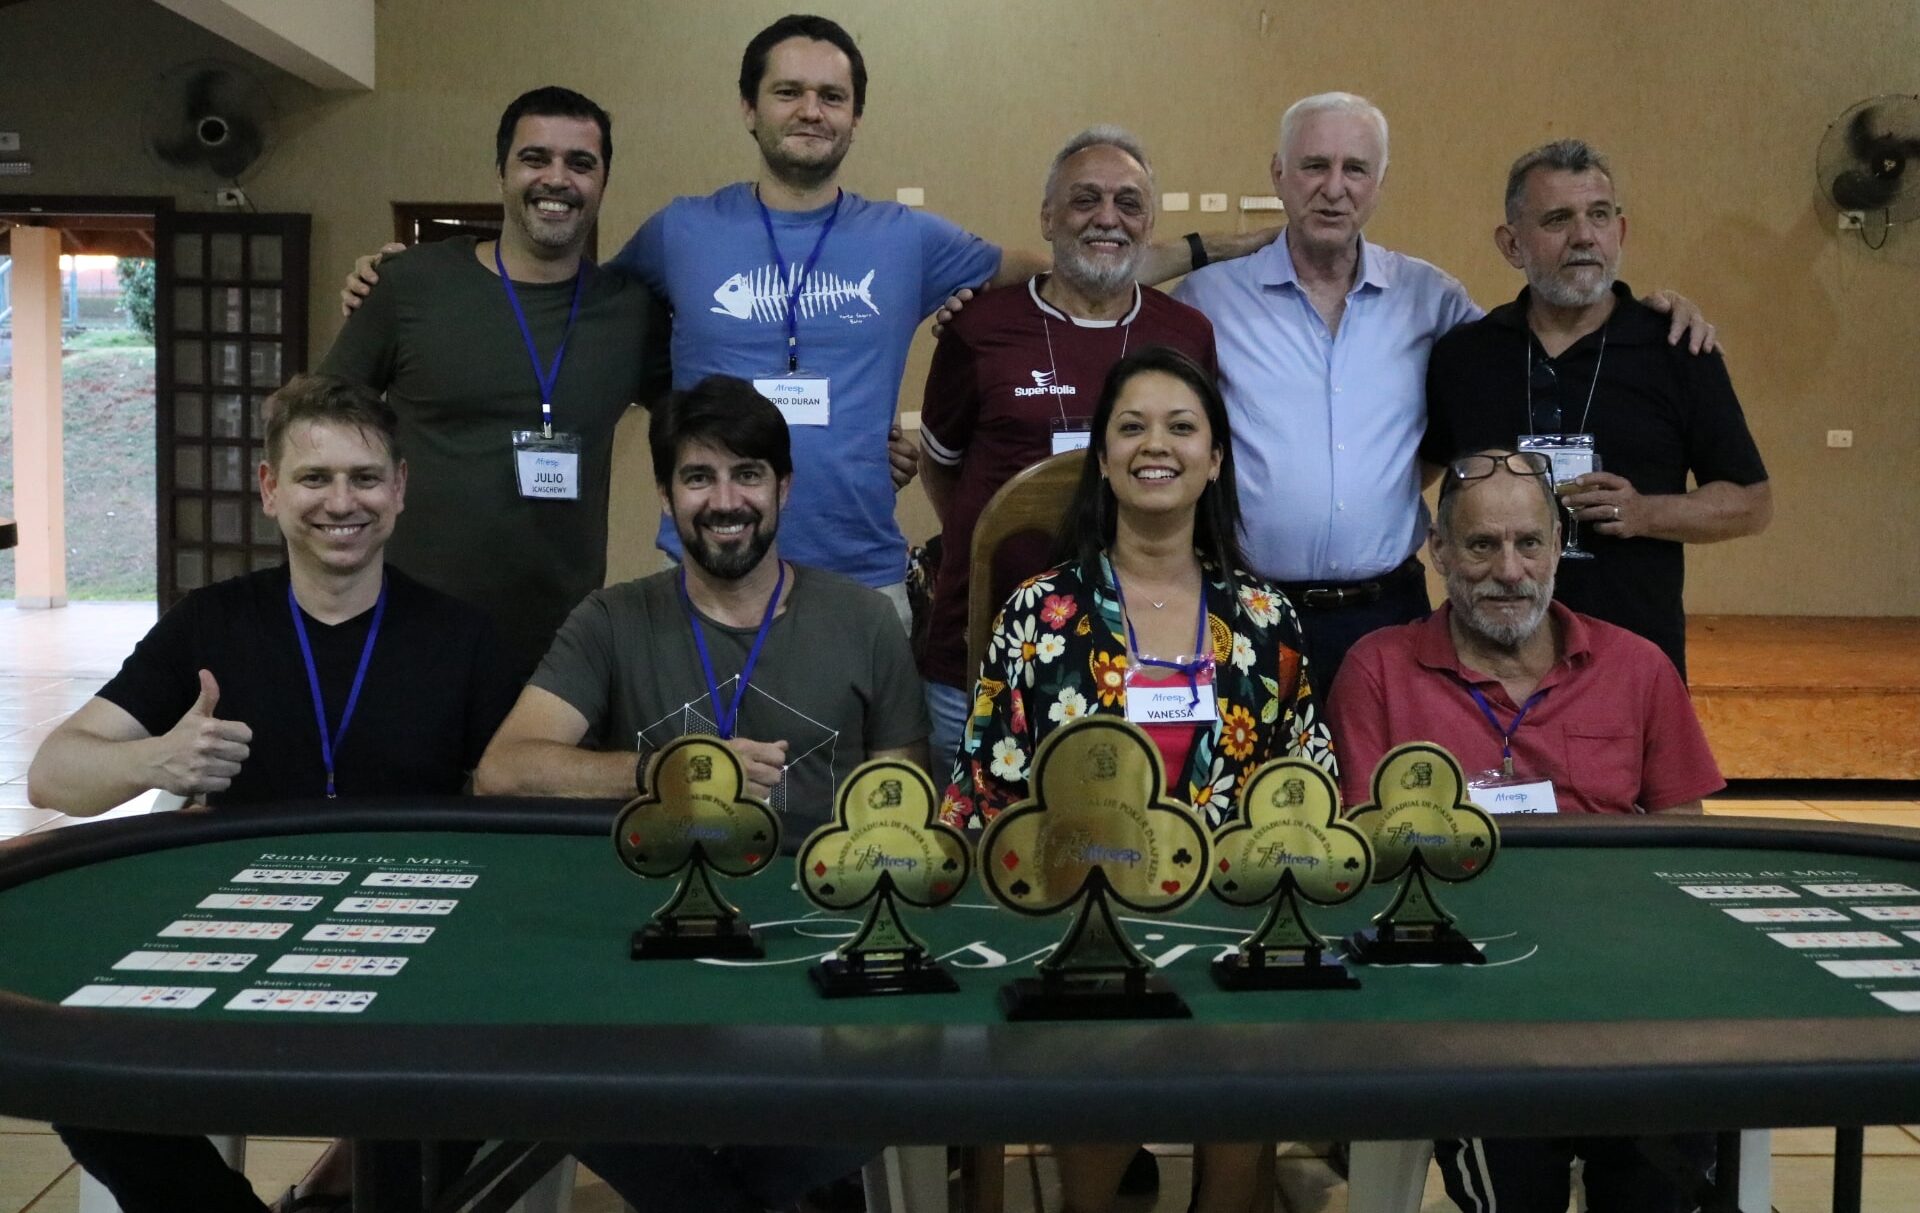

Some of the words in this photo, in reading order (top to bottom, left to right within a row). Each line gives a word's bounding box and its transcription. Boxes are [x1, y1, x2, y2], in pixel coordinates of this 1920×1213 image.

[774, 383, 804, 394] Afresp
[1014, 387, 1048, 397] Super
[1049, 385, 1076, 395] Bolla
[534, 473, 563, 484] JULIO
[1152, 694, 1186, 704] Afresp
[1147, 709, 1194, 719] VANESSA
[259, 853, 359, 864] Ranking
[405, 857, 472, 866] Mãos
[1654, 871, 1752, 879] Ranking
